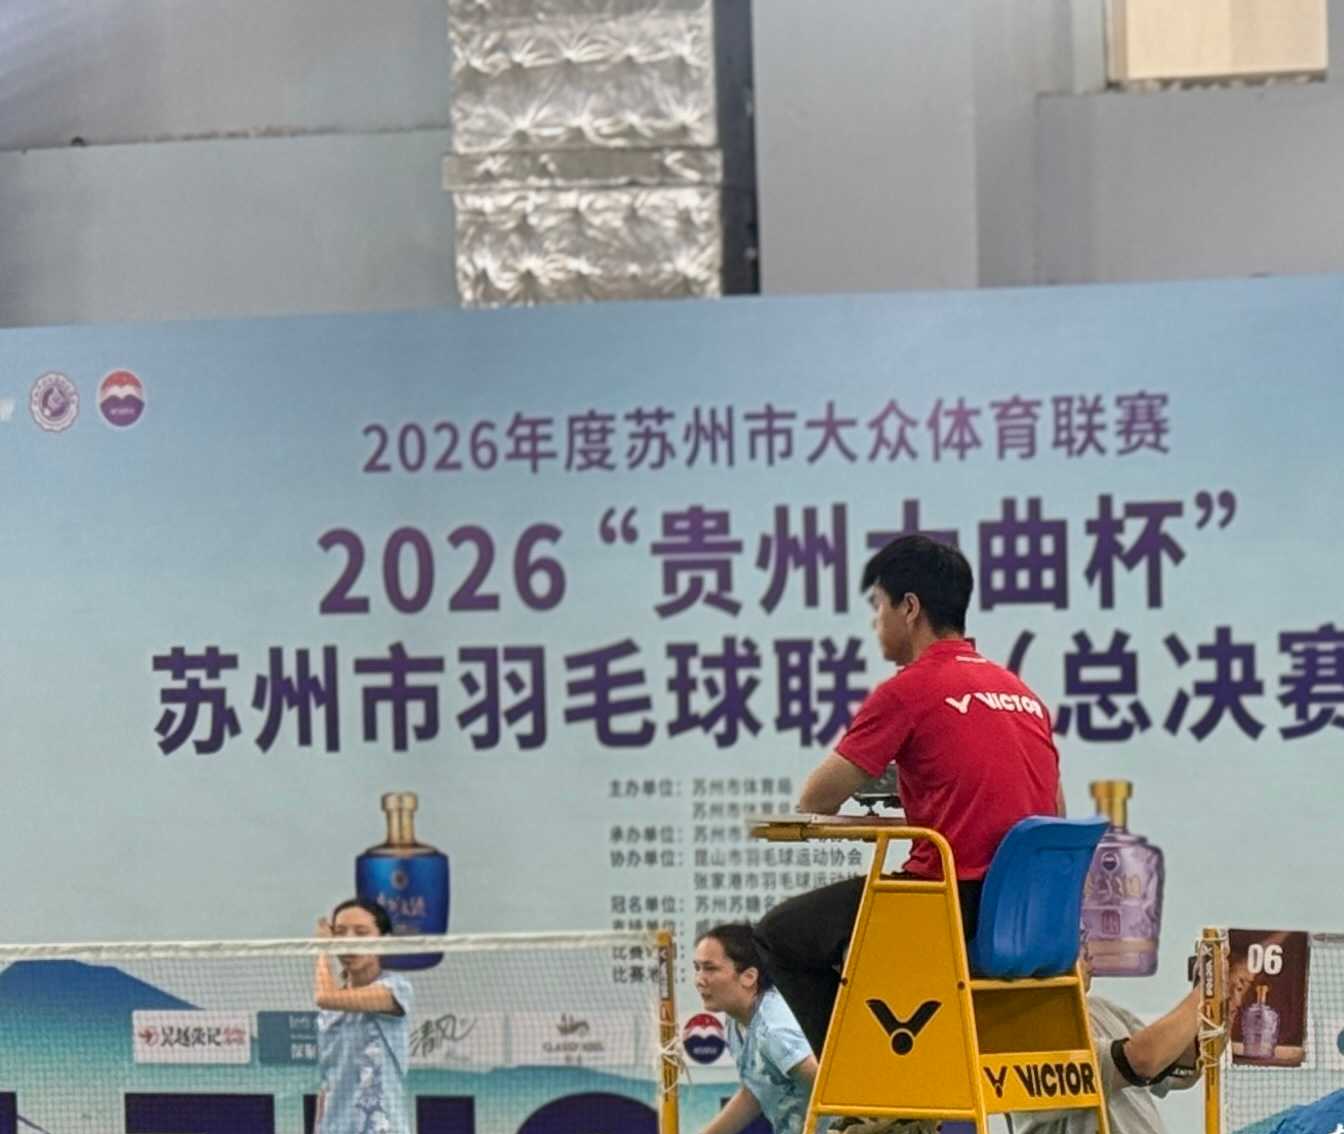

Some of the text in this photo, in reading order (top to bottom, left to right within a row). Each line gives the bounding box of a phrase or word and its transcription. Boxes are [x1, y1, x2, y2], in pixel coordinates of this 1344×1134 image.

[362, 392, 1171, 474] 2026年度苏州市大众体育联赛
[973, 692, 1044, 719] VICTOR
[694, 847, 863, 868] 昆山市羽毛球运动协会
[1247, 944, 1283, 976] 06
[1014, 1062, 1096, 1098] VICTOR
